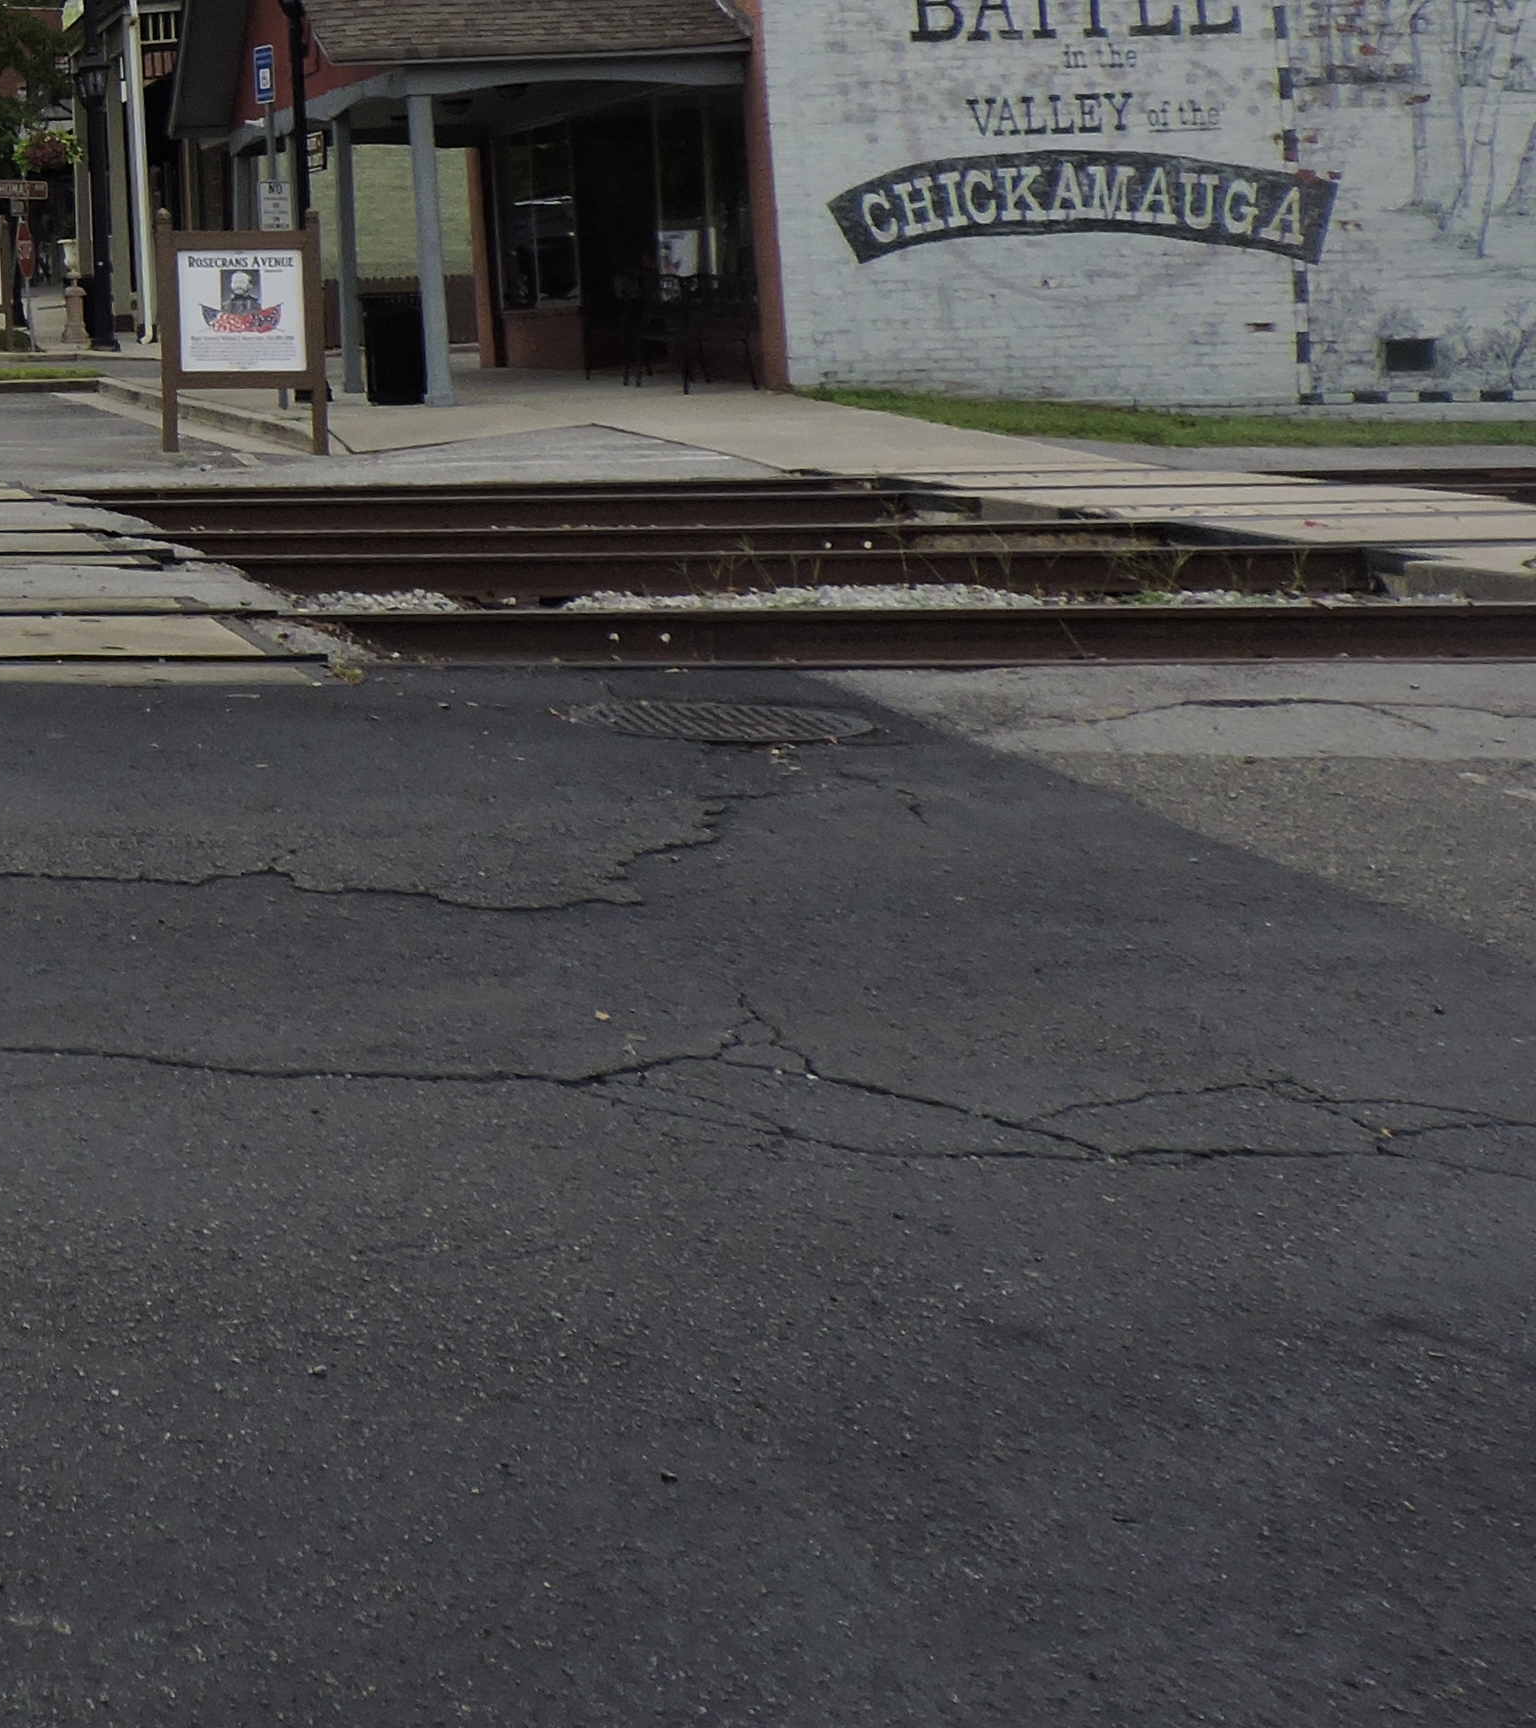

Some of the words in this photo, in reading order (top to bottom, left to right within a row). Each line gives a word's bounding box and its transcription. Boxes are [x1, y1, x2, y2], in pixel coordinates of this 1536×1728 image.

[1063, 43, 1088, 68] in
[1095, 43, 1138, 68] the
[965, 92, 1134, 136] VALLEY
[1147, 100, 1171, 127] of
[1177, 99, 1221, 126] the
[860, 162, 1305, 246] CHICKAMAUGA
[188, 256, 249, 268] ROSECRANS
[252, 256, 295, 268] AVENUE
